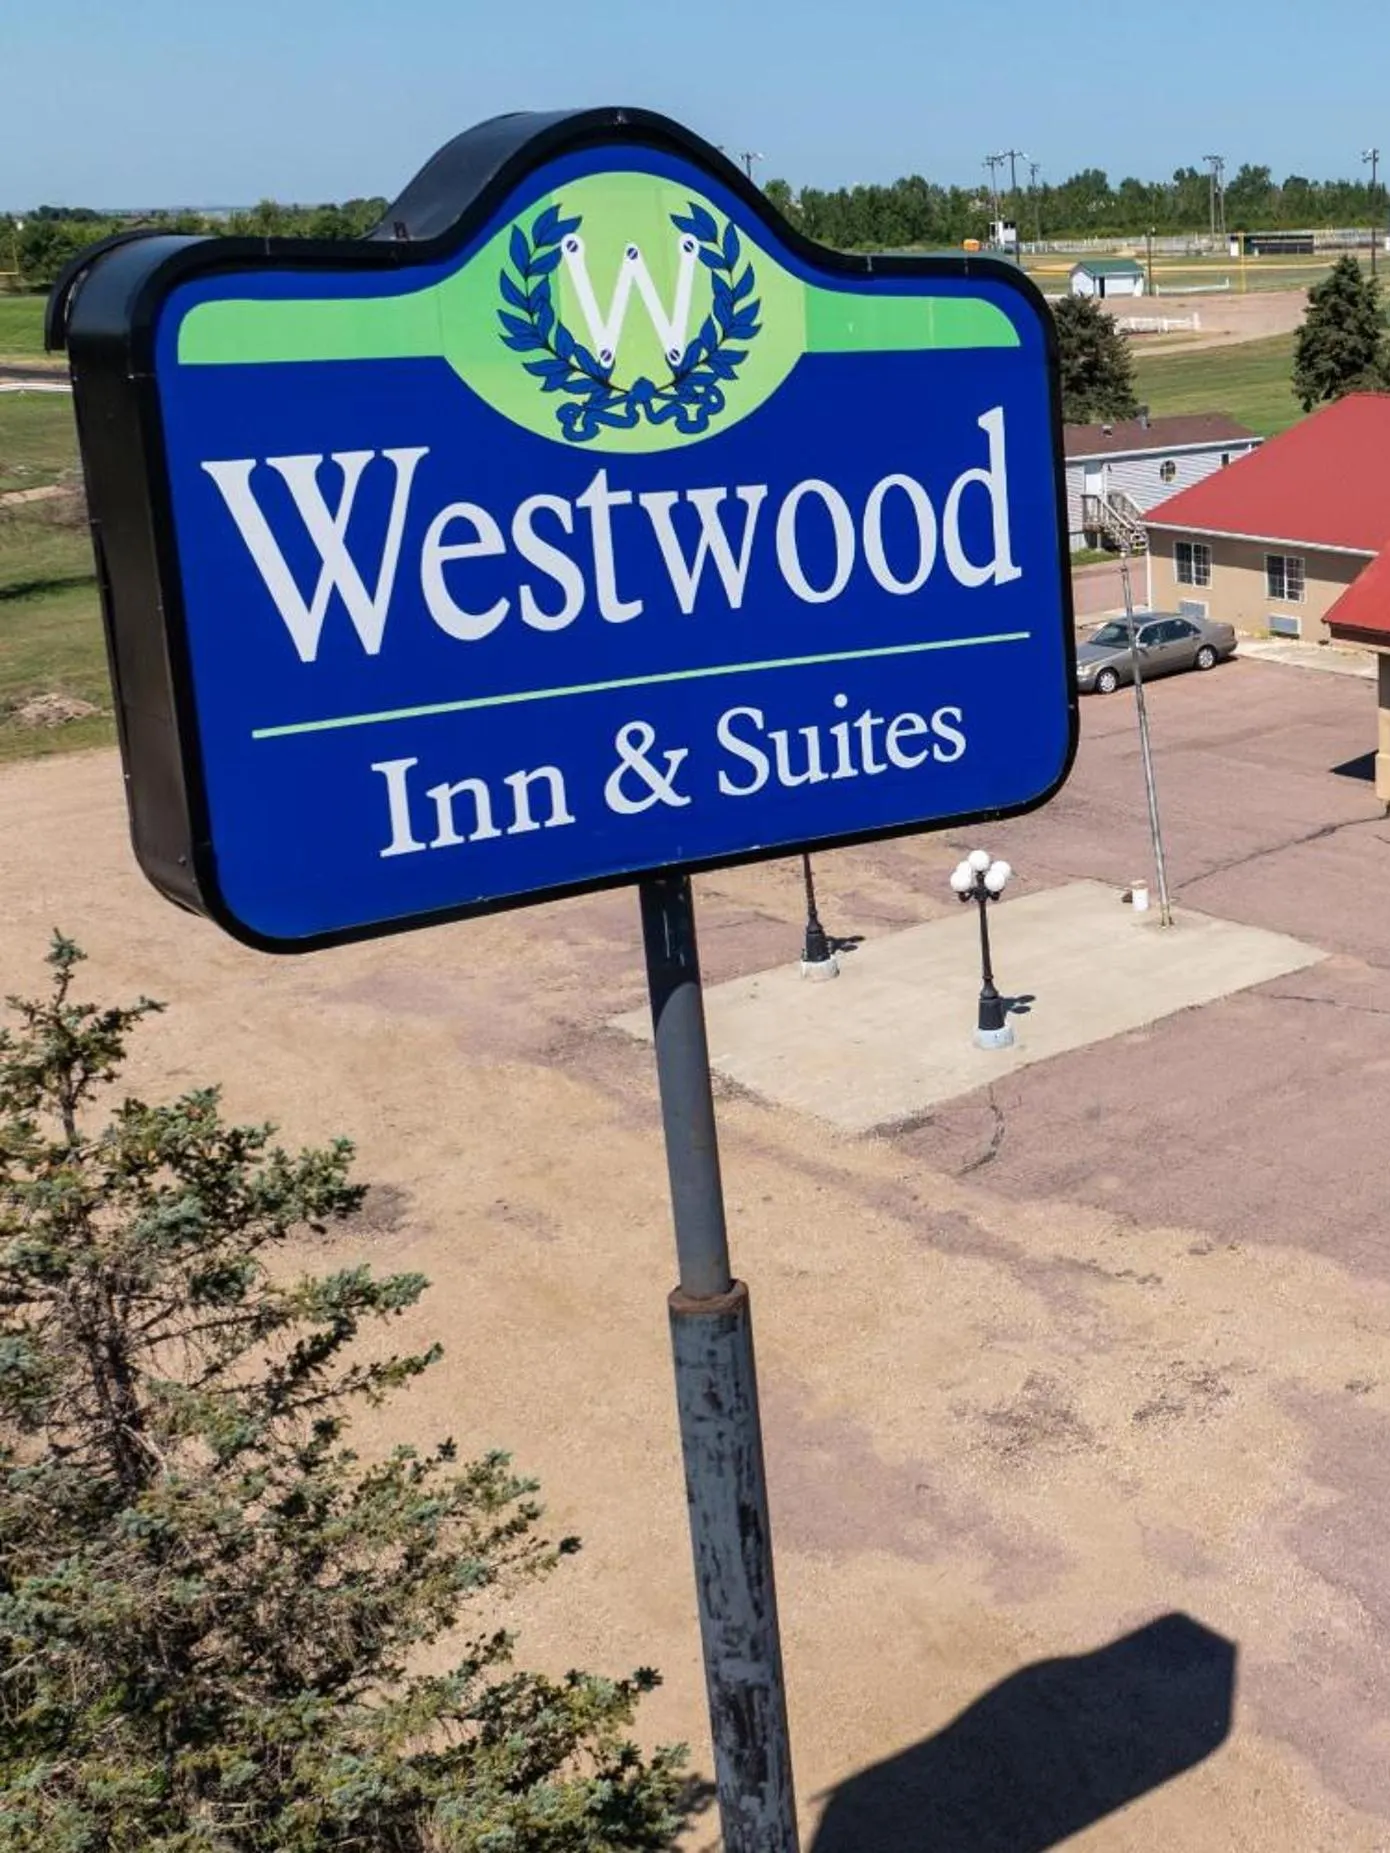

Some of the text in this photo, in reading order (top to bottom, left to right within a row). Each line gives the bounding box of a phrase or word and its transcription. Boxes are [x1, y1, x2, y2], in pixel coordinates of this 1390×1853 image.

[561, 233, 700, 368] W
[201, 406, 1022, 663] Westwood
[371, 693, 966, 857] Inn & Suites
